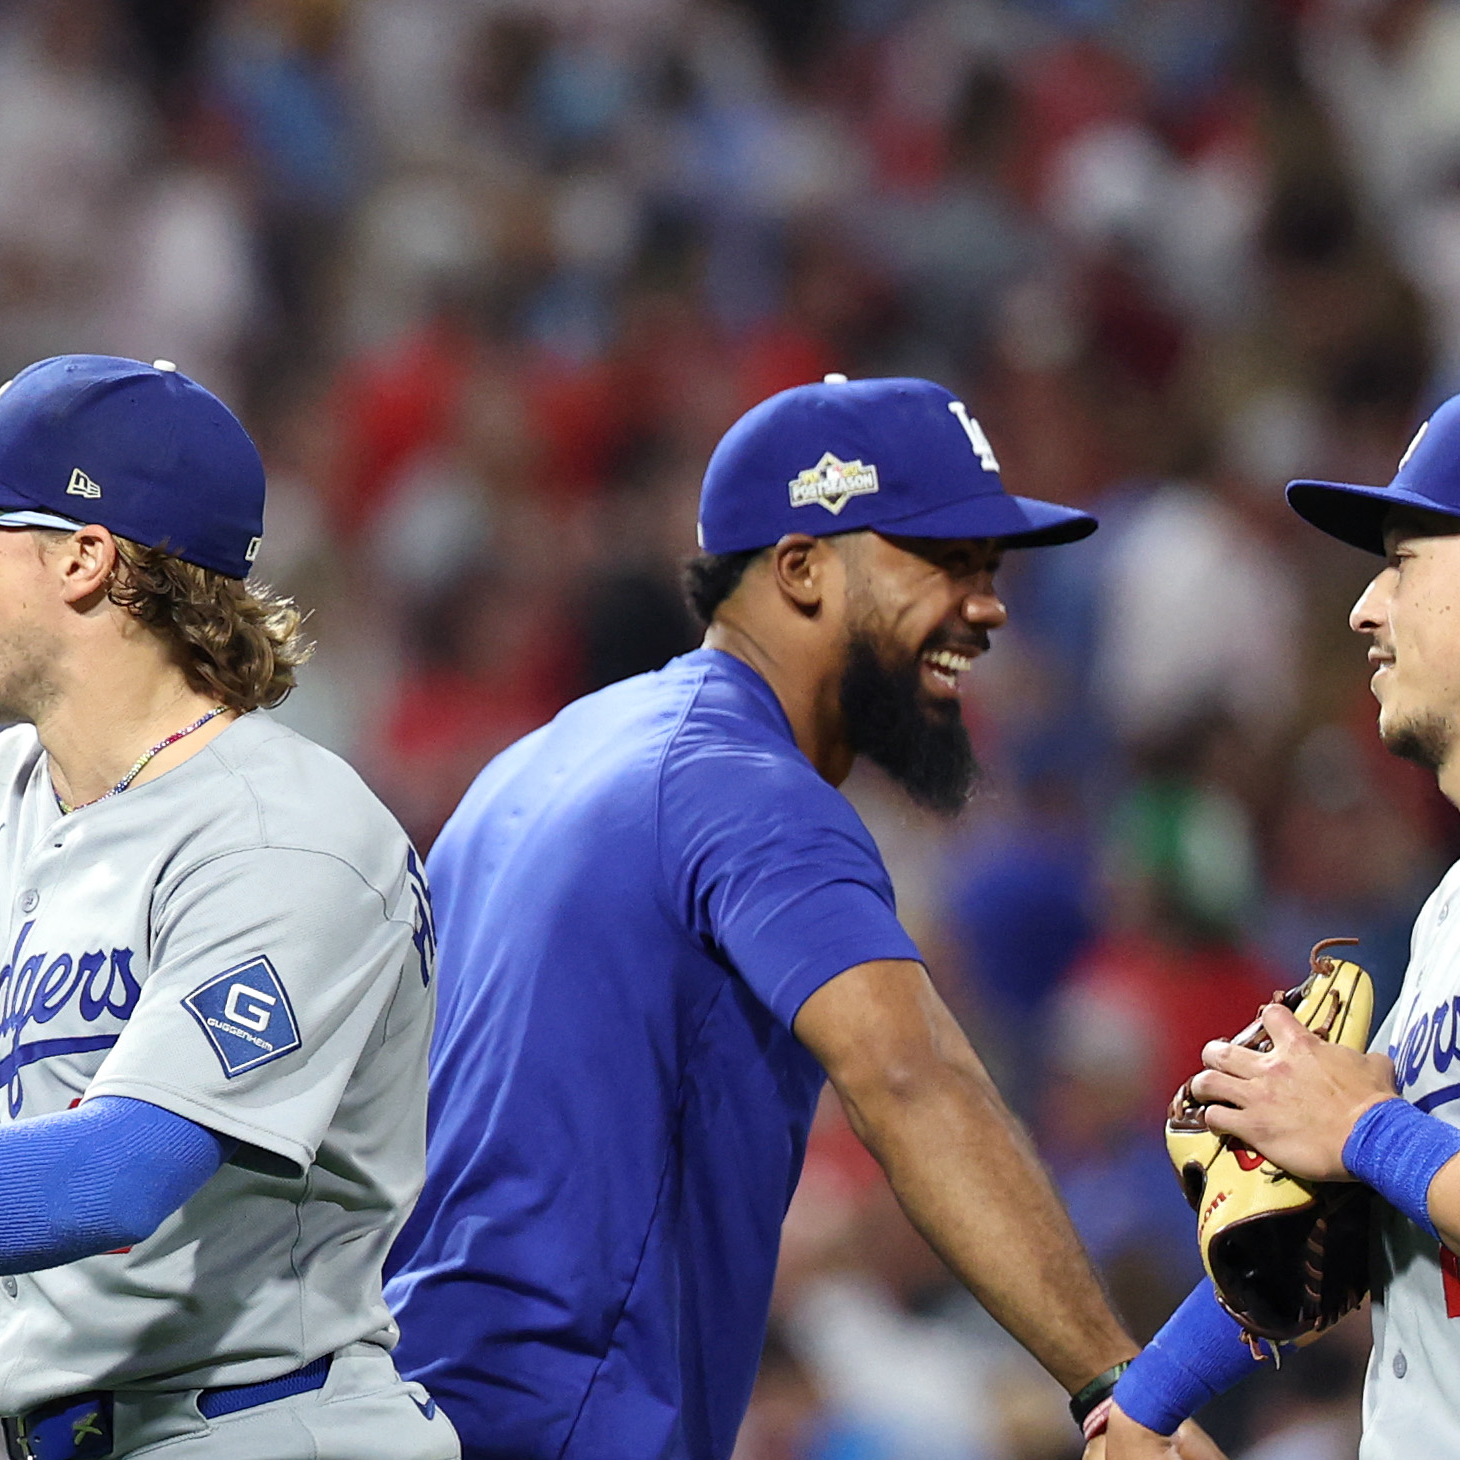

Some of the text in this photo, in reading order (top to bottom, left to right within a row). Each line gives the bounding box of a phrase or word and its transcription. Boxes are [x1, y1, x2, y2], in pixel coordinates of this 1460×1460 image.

[792, 472, 873, 501] POSTSEASON
[224, 983, 277, 1032] G
[207, 1017, 274, 1051] GUGGENHEIM
